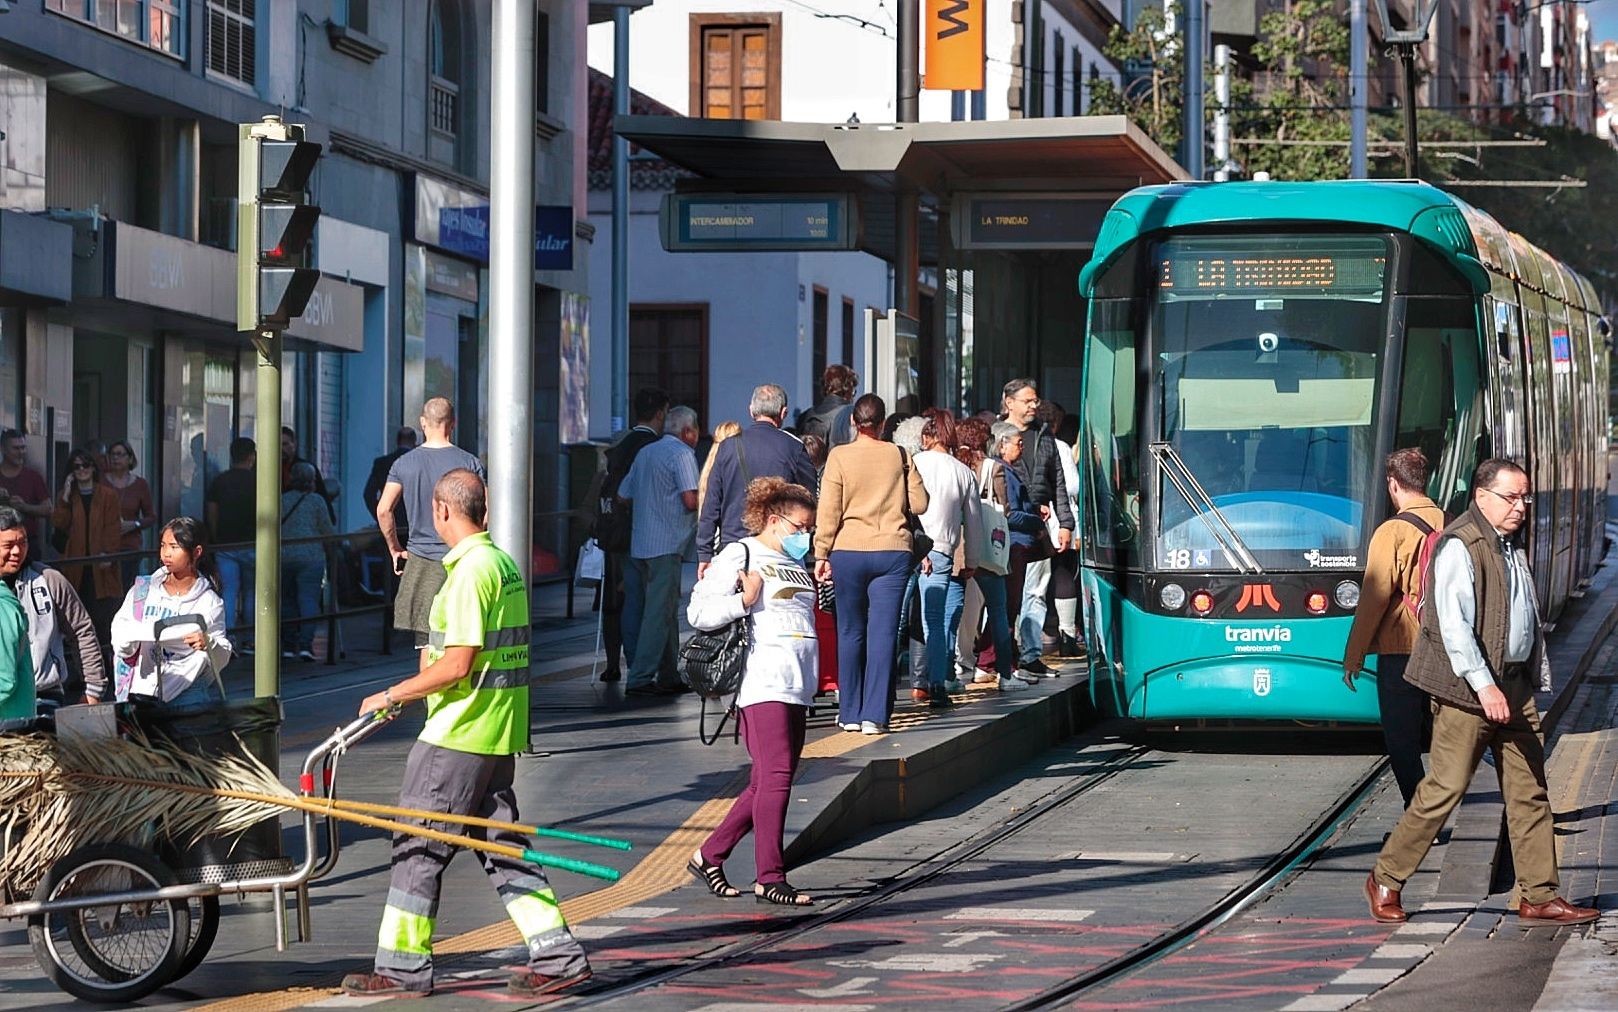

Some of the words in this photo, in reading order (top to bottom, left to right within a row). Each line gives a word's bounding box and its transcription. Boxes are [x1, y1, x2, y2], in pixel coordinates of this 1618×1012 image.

[981, 216, 992, 225] LA
[995, 216, 1029, 225] TRINIDAD
[536, 234, 569, 251] ular
[1198, 259, 1225, 287] LA
[1232, 258, 1334, 287] TRINIDAD
[1165, 550, 1191, 569] 18
[1225, 624, 1292, 642] tranvía
[1234, 643, 1283, 653] metrotenerife
